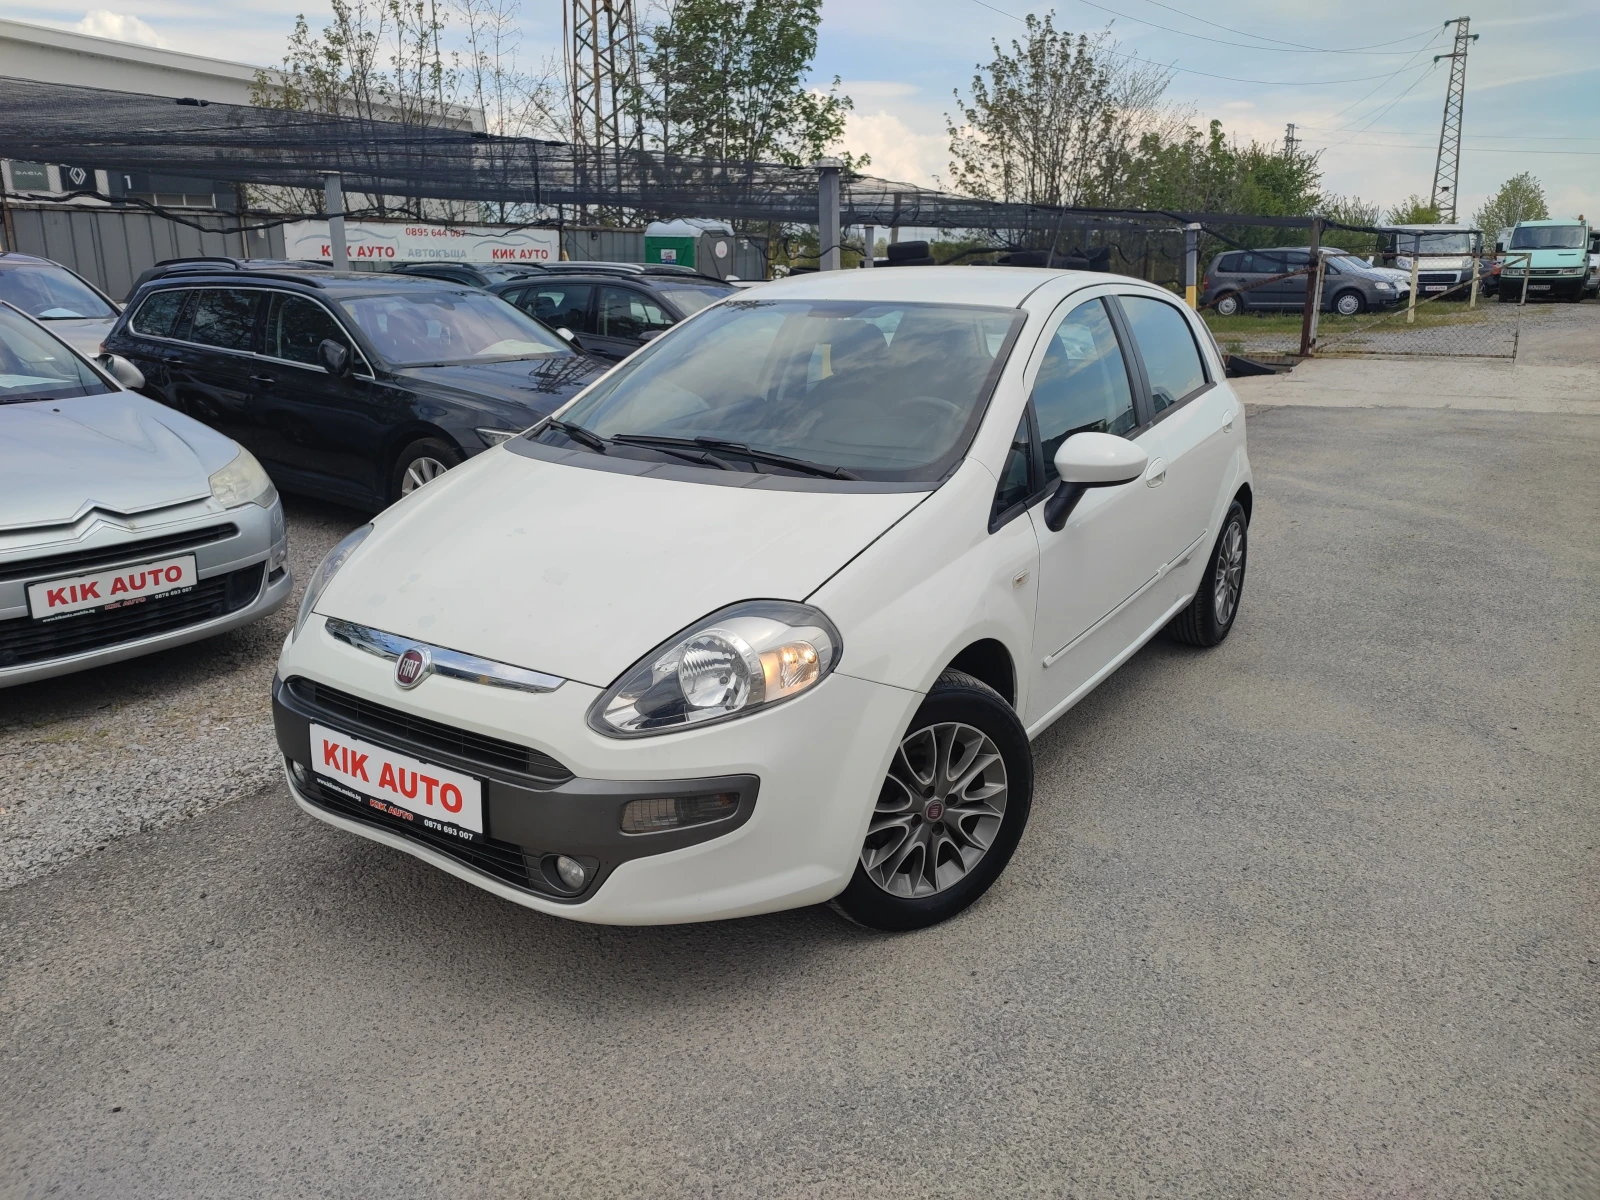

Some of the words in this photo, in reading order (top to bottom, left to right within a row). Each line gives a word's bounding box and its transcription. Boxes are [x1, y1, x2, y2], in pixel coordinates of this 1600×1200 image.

[405, 227, 429, 237] 0895
[431, 229, 447, 237] 644
[321, 244, 352, 257] КК
[357, 245, 395, 258] АУТО
[492, 248, 516, 259] КИК
[519, 249, 549, 260] АУТО
[46, 580, 101, 608] KIK
[110, 565, 183, 595] AUTO
[122, 597, 147, 607] AUTO
[398, 657, 420, 679] FIAT
[323, 739, 370, 783] KIK
[378, 762, 463, 814] AUTO
[369, 798, 388, 812] KIK
[387, 805, 414, 821] AUTO
[424, 819, 442, 831] 0878
[443, 825, 457, 836] 693
[458, 830, 474, 841] 007
